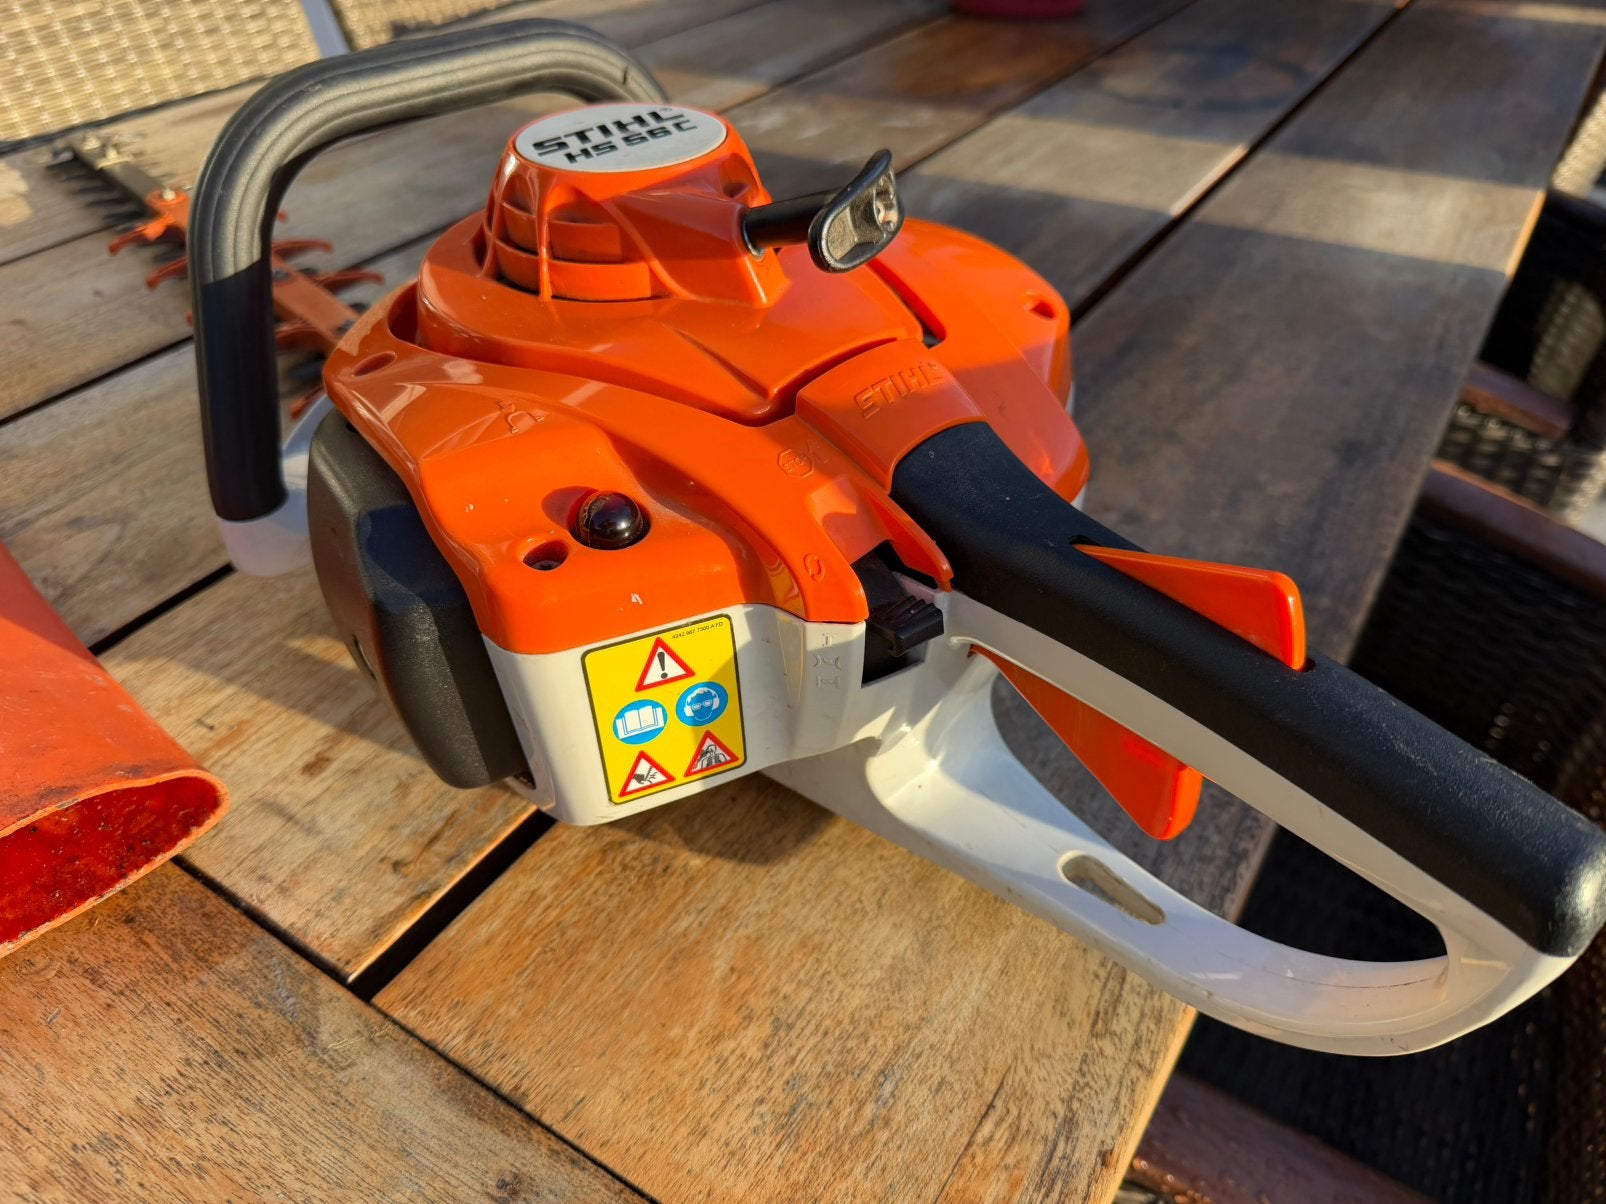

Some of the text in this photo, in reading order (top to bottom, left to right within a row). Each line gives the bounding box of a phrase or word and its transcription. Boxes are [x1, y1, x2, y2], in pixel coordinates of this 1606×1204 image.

[532, 111, 686, 157] STIHL
[564, 119, 697, 164] HS 56 C
[853, 366, 945, 419] STIHL
